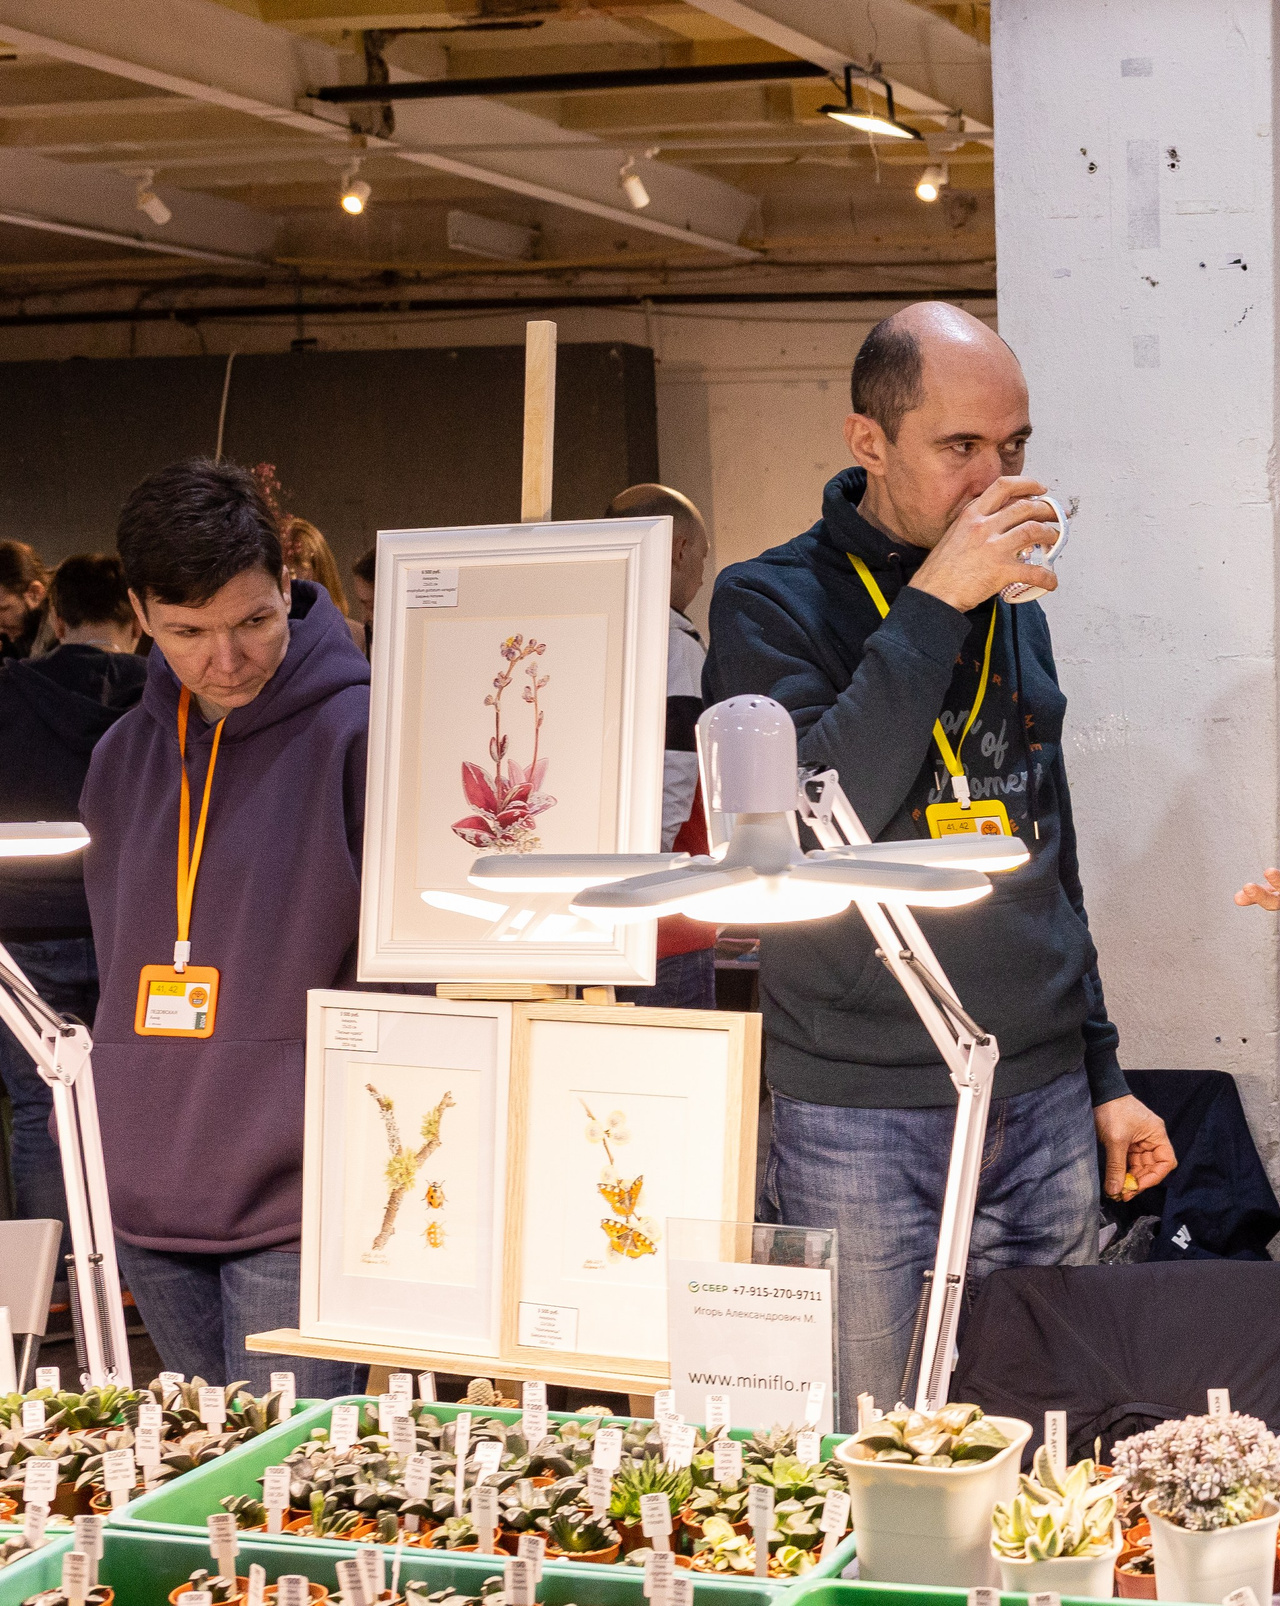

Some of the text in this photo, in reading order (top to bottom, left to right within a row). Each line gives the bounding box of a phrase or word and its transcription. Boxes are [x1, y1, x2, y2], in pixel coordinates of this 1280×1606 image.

[981, 718, 1009, 769] of
[959, 822, 970, 830] 42
[702, 1283, 822, 1302] СБЕР +7-915-270-9711
[694, 1306, 816, 1324] Игорь Александрович М.
